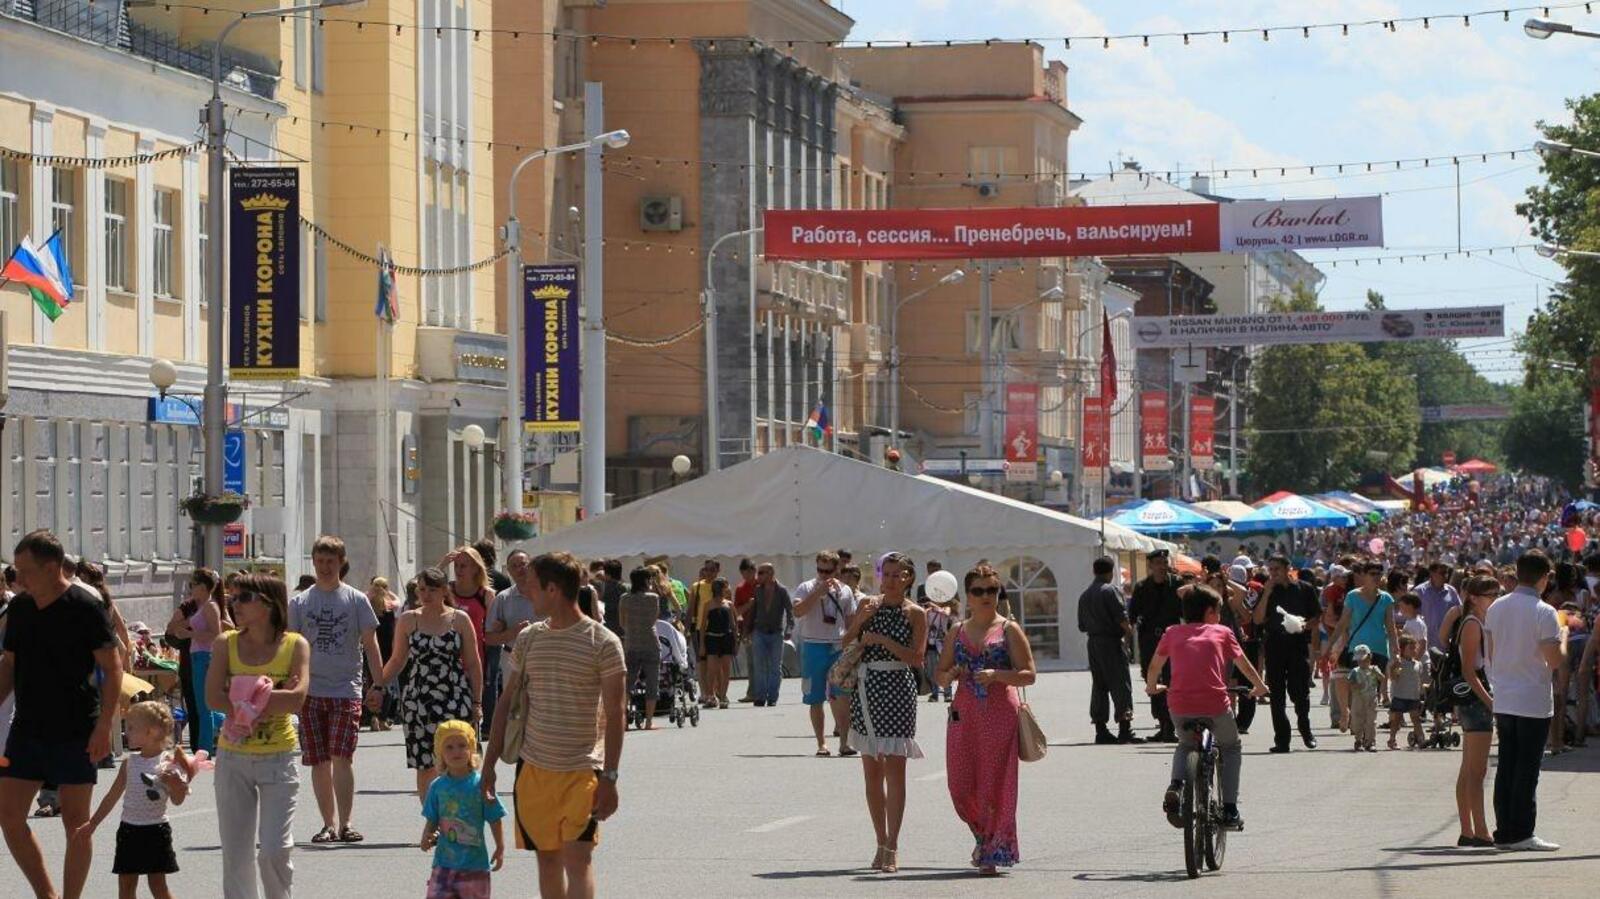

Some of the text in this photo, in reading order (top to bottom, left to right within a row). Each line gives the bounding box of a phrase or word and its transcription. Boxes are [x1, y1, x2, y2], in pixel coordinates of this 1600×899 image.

[251, 178, 296, 188] 272-65-84
[1252, 203, 1351, 228] Barhat
[791, 218, 1192, 247] Работа, сессия... Пренебречь, вальсируем!
[1235, 235, 1280, 247] Цюрупы,
[1281, 234, 1294, 244] 42
[256, 211, 273, 366] КУХНИ КОРОНА
[1169, 318, 1211, 326] NISSAN
[1215, 316, 1265, 325] MURANO
[545, 299, 560, 421] КУХНИ КОРОНА
